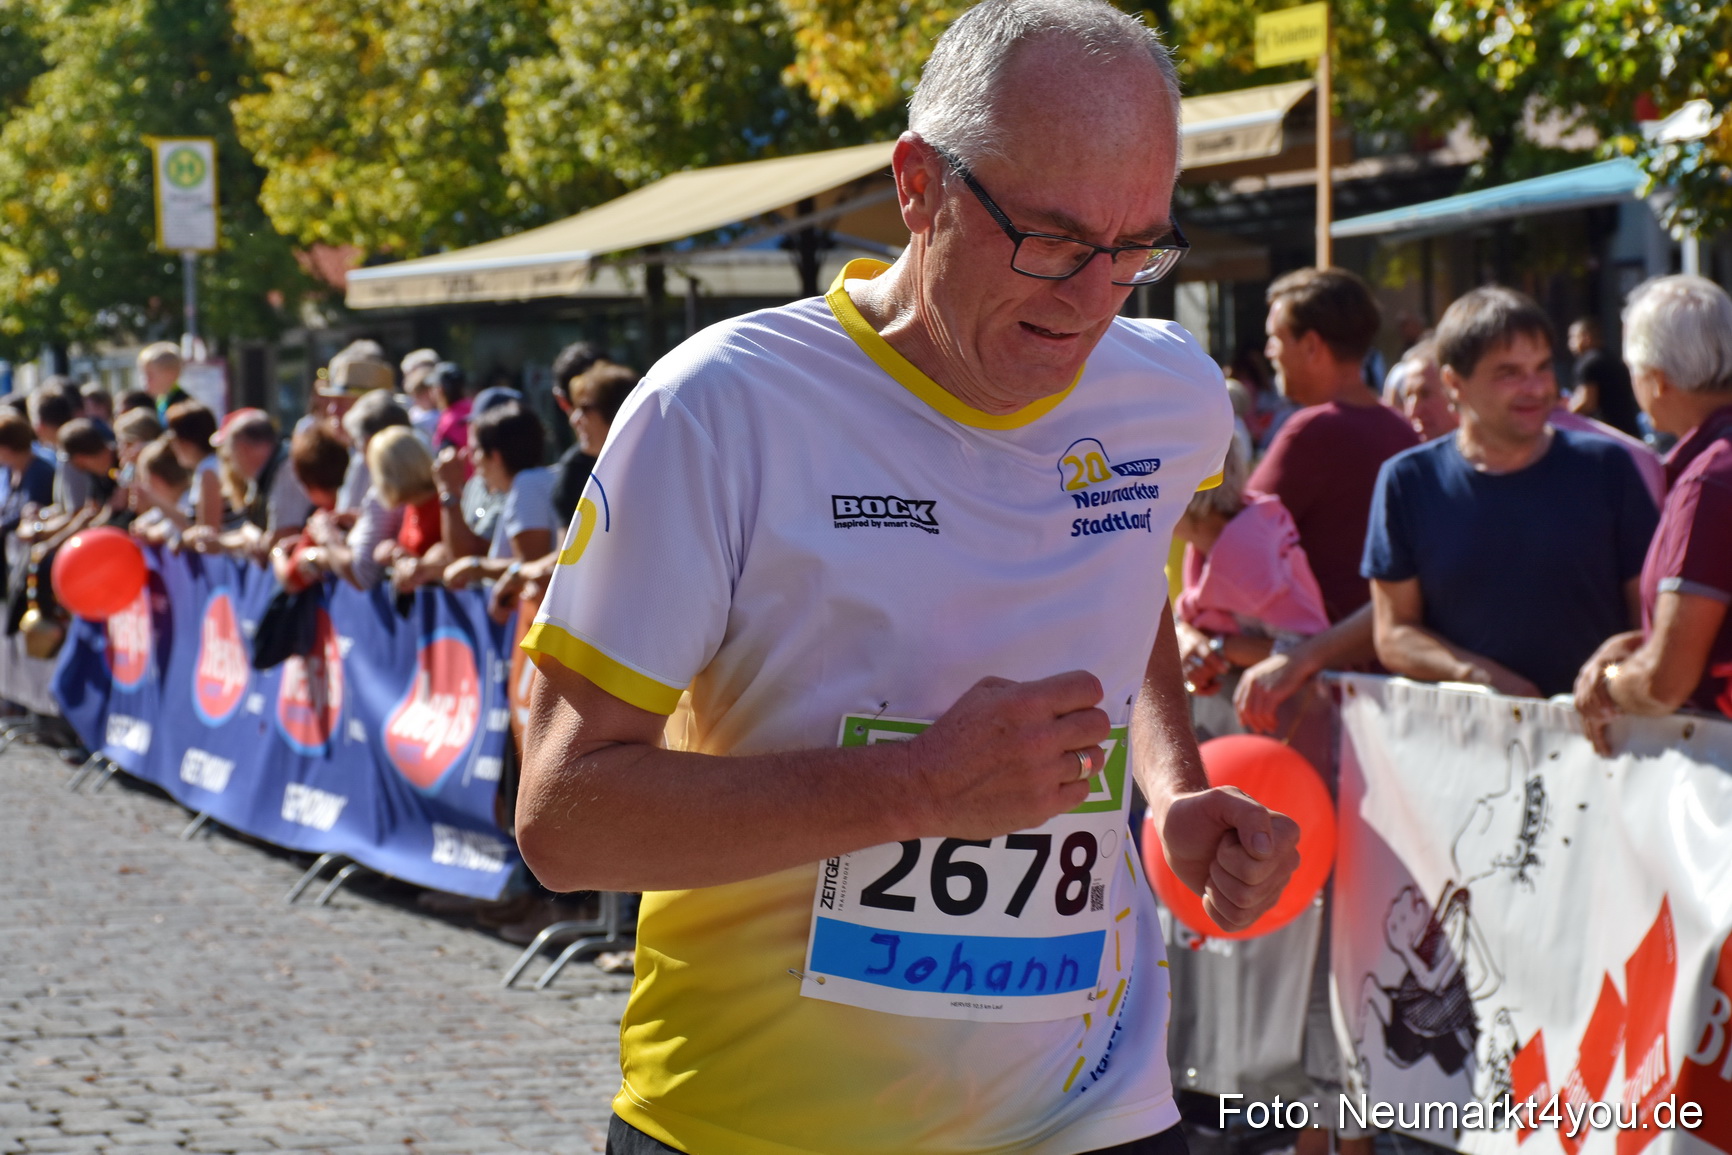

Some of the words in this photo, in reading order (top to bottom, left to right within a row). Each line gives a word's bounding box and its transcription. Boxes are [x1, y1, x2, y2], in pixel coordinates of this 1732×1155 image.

[1062, 451, 1113, 491] 20
[1118, 460, 1159, 475] JAHRE
[832, 494, 939, 526] BOCK
[1071, 481, 1160, 509] Neumarkter
[834, 519, 869, 530] inspired
[871, 519, 881, 529] by
[884, 520, 908, 528] smart
[1070, 507, 1152, 537] Stadtlauf
[860, 830, 1098, 919] 2678
[864, 933, 1079, 993] Johann
